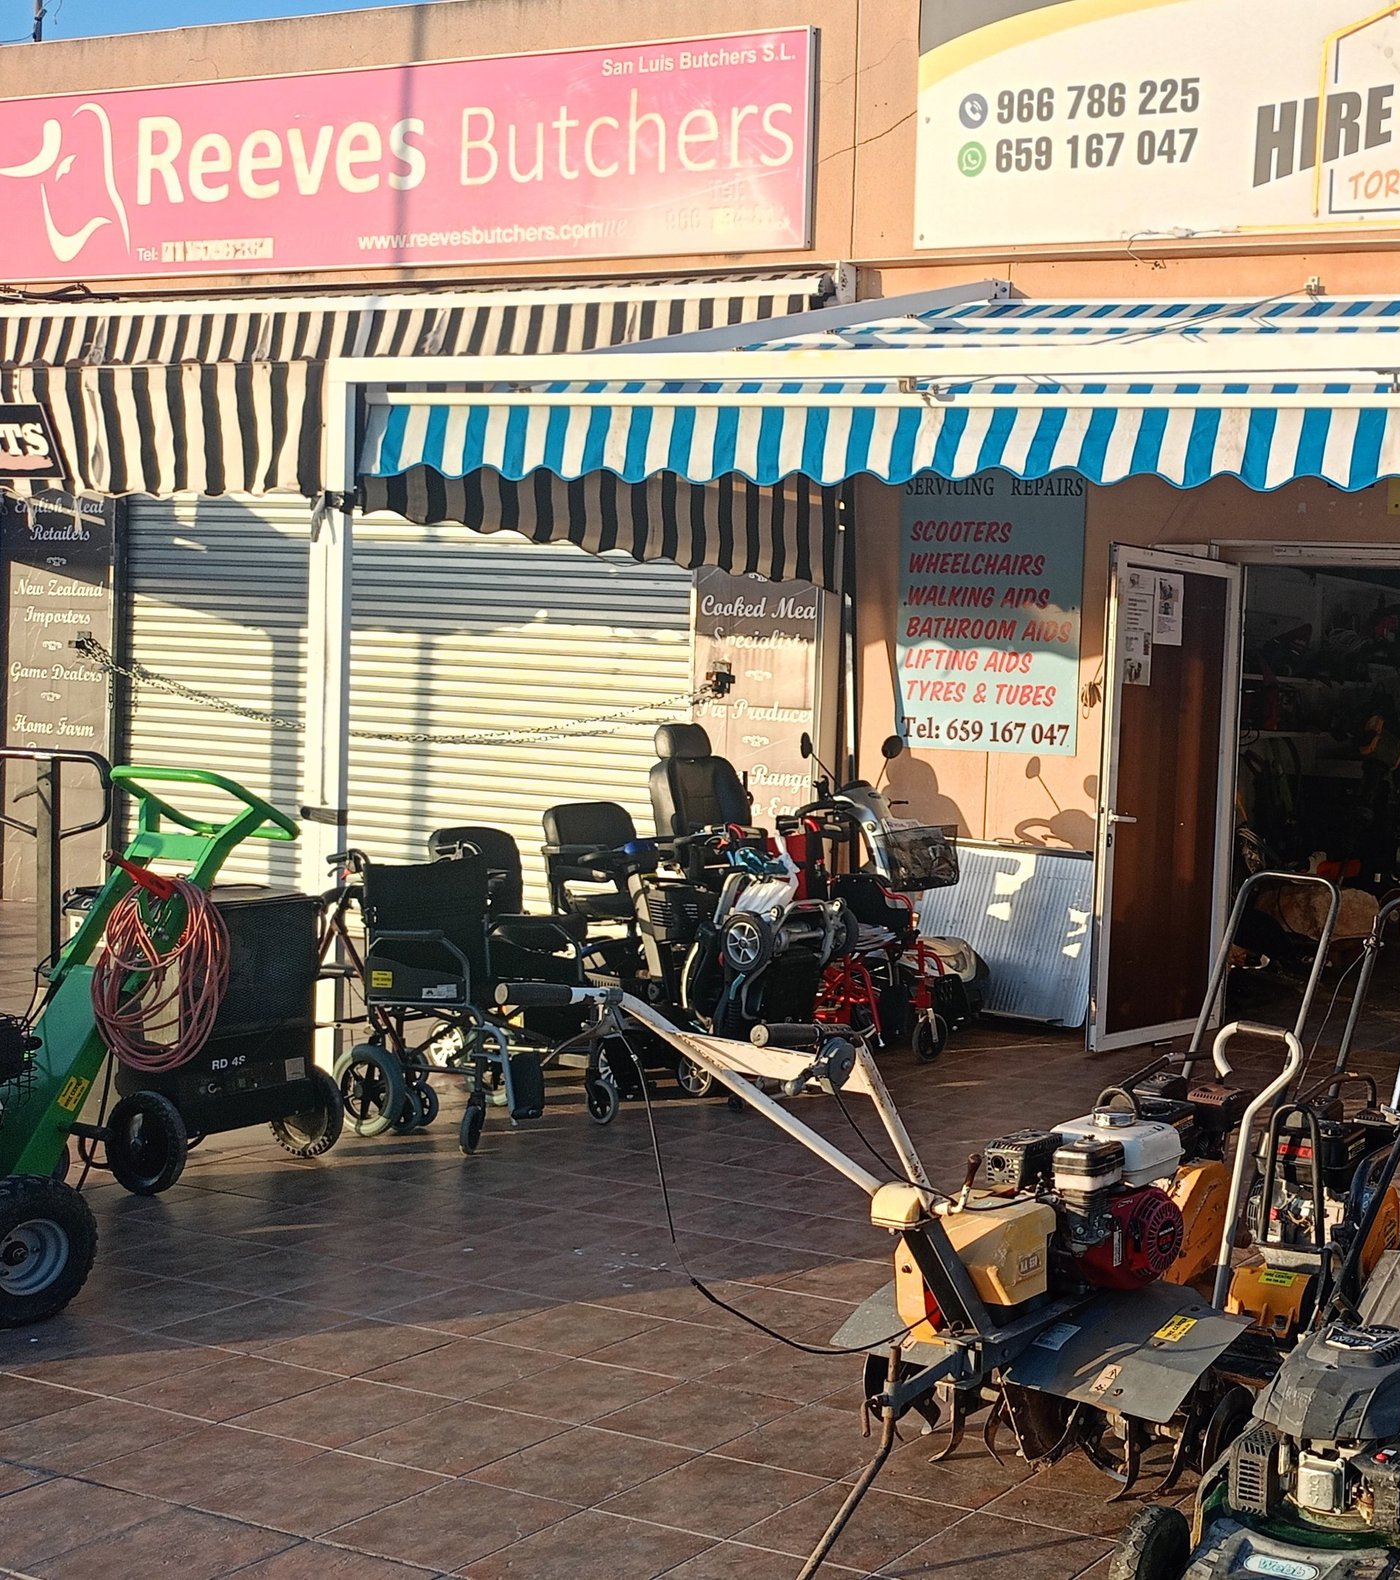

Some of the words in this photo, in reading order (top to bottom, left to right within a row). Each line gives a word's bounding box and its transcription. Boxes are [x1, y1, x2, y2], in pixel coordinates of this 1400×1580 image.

[601, 58, 633, 76] San
[639, 54, 673, 74] Luis
[680, 48, 757, 70] Butchers
[762, 43, 796, 62] S.L.
[997, 87, 1055, 124] 966
[1067, 82, 1126, 119] 786
[1138, 77, 1200, 115] 225
[136, 115, 426, 205] Reeves
[460, 88, 794, 186] Butchers
[1252, 84, 1395, 188] HIRE
[995, 136, 1053, 173] 659
[1067, 132, 1125, 169] 167
[1137, 128, 1198, 165] 047
[357, 222, 602, 250] www.reevesbutchers.com
[136, 247, 159, 261] Tel:
[905, 477, 994, 496] SERVICING
[1011, 477, 1083, 497] REPAIRS
[30, 524, 90, 541] Retailers
[911, 520, 1013, 543] SCOOTERS
[909, 552, 1046, 576] WHEELCHAIRS
[14, 579, 45, 596] New
[47, 580, 103, 597] Zealand
[908, 585, 995, 607] WALKING
[1000, 587, 1050, 609] AIDS
[24, 606, 90, 628] Importers
[701, 594, 767, 618] Cooked
[712, 626, 809, 650] Specialists
[906, 616, 1018, 641] BATHROOM
[1022, 620, 1073, 643] AIDS
[11, 661, 48, 682] Game
[51, 663, 103, 682] Dealers
[904, 648, 979, 672] LIFTING
[984, 650, 1033, 674] AIDS
[907, 680, 967, 702] TYRES
[973, 682, 987, 704] &
[996, 684, 1057, 707] TUBES
[732, 698, 813, 723] Produce
[12, 713, 54, 734] Home
[57, 716, 95, 737] Farm
[901, 716, 940, 739] Tel:
[946, 718, 983, 742] 659
[989, 721, 1027, 744] 167
[1031, 723, 1070, 746] 047
[749, 763, 812, 794] Range
[211, 1058, 229, 1070] RD
[1258, 1558, 1305, 1577] Webb
